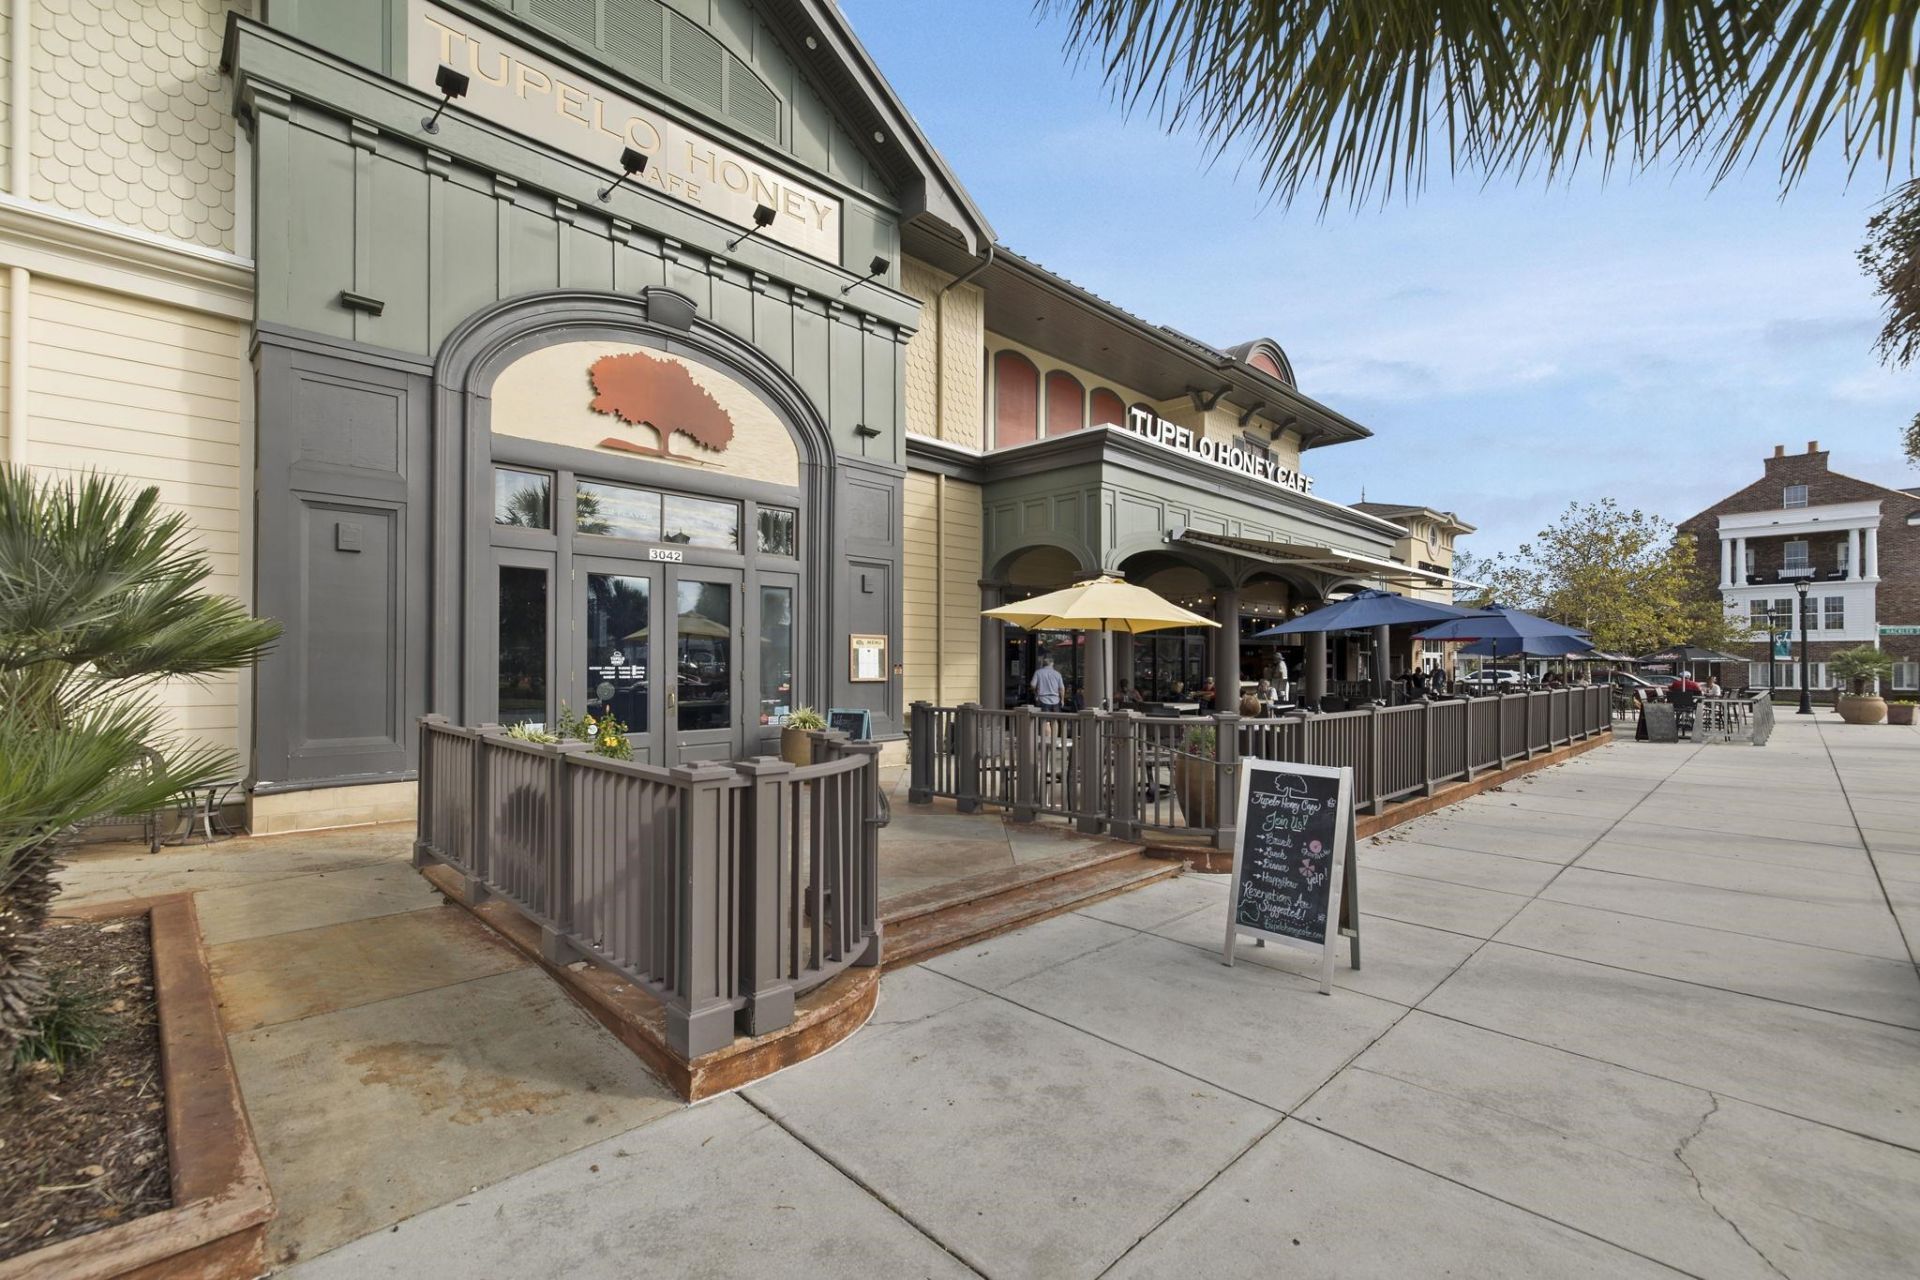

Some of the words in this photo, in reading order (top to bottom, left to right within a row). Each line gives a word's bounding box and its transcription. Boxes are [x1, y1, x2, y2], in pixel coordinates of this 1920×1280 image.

[425, 14, 662, 155] TUPELO
[684, 140, 833, 232] HONEY
[634, 164, 702, 204] AFE
[1131, 406, 1214, 459] TUPELO
[1219, 442, 1275, 481] HONEY
[1277, 466, 1314, 495] CAFE
[651, 549, 681, 561] 3042
[1251, 793, 1280, 809] Tupelo
[1281, 797, 1300, 814] Honey
[1301, 799, 1321, 815] Cafe
[1262, 811, 1288, 831] Join
[1290, 814, 1309, 830] Us!
[1265, 832, 1293, 848] Brunch
[1263, 846, 1287, 860] Lunch
[1262, 859, 1289, 873] Dinner
[1242, 880, 1292, 906] Reservations
